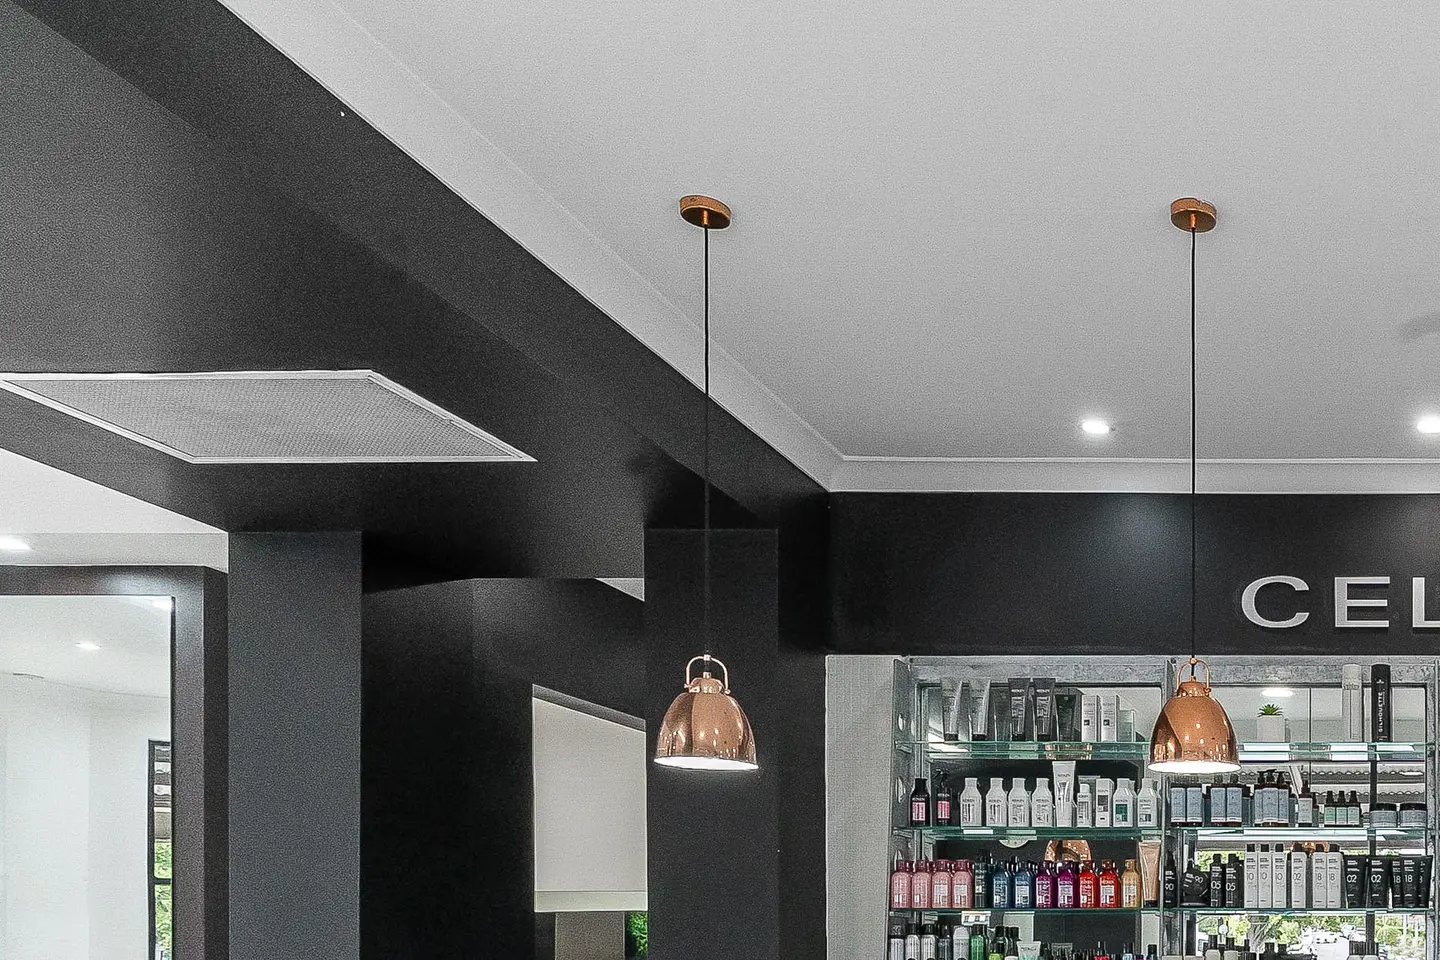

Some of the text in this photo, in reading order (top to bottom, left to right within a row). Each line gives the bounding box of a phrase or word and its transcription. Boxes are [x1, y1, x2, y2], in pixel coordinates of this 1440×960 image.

[1346, 874, 1357, 883] 02
[1371, 874, 1382, 883] 02
[1405, 874, 1413, 882] 18
[1211, 881, 1221, 889] 05
[1226, 883, 1235, 891] 05
